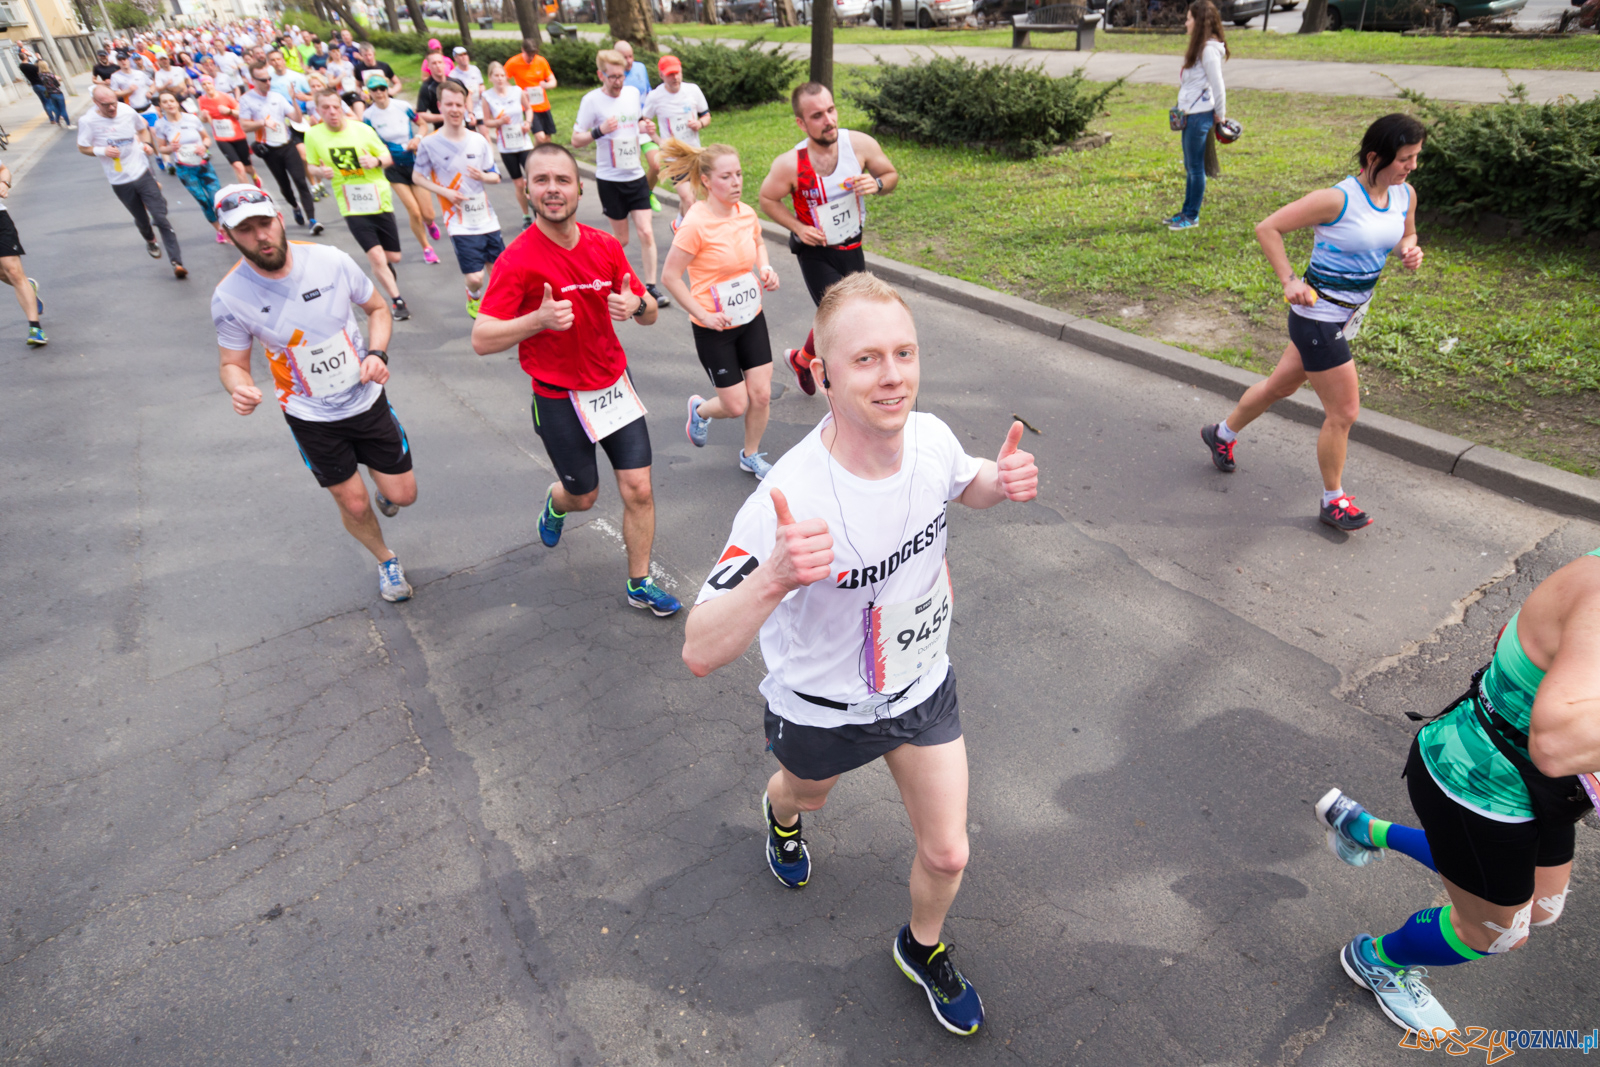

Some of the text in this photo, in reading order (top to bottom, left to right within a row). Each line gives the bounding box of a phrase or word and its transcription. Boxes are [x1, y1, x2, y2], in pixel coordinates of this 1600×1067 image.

[352, 193, 373, 201] 2862
[833, 209, 851, 226] 571
[727, 287, 757, 307] 4070
[311, 351, 347, 375] 4107
[589, 386, 623, 413] 7274
[897, 594, 949, 652] 9455
